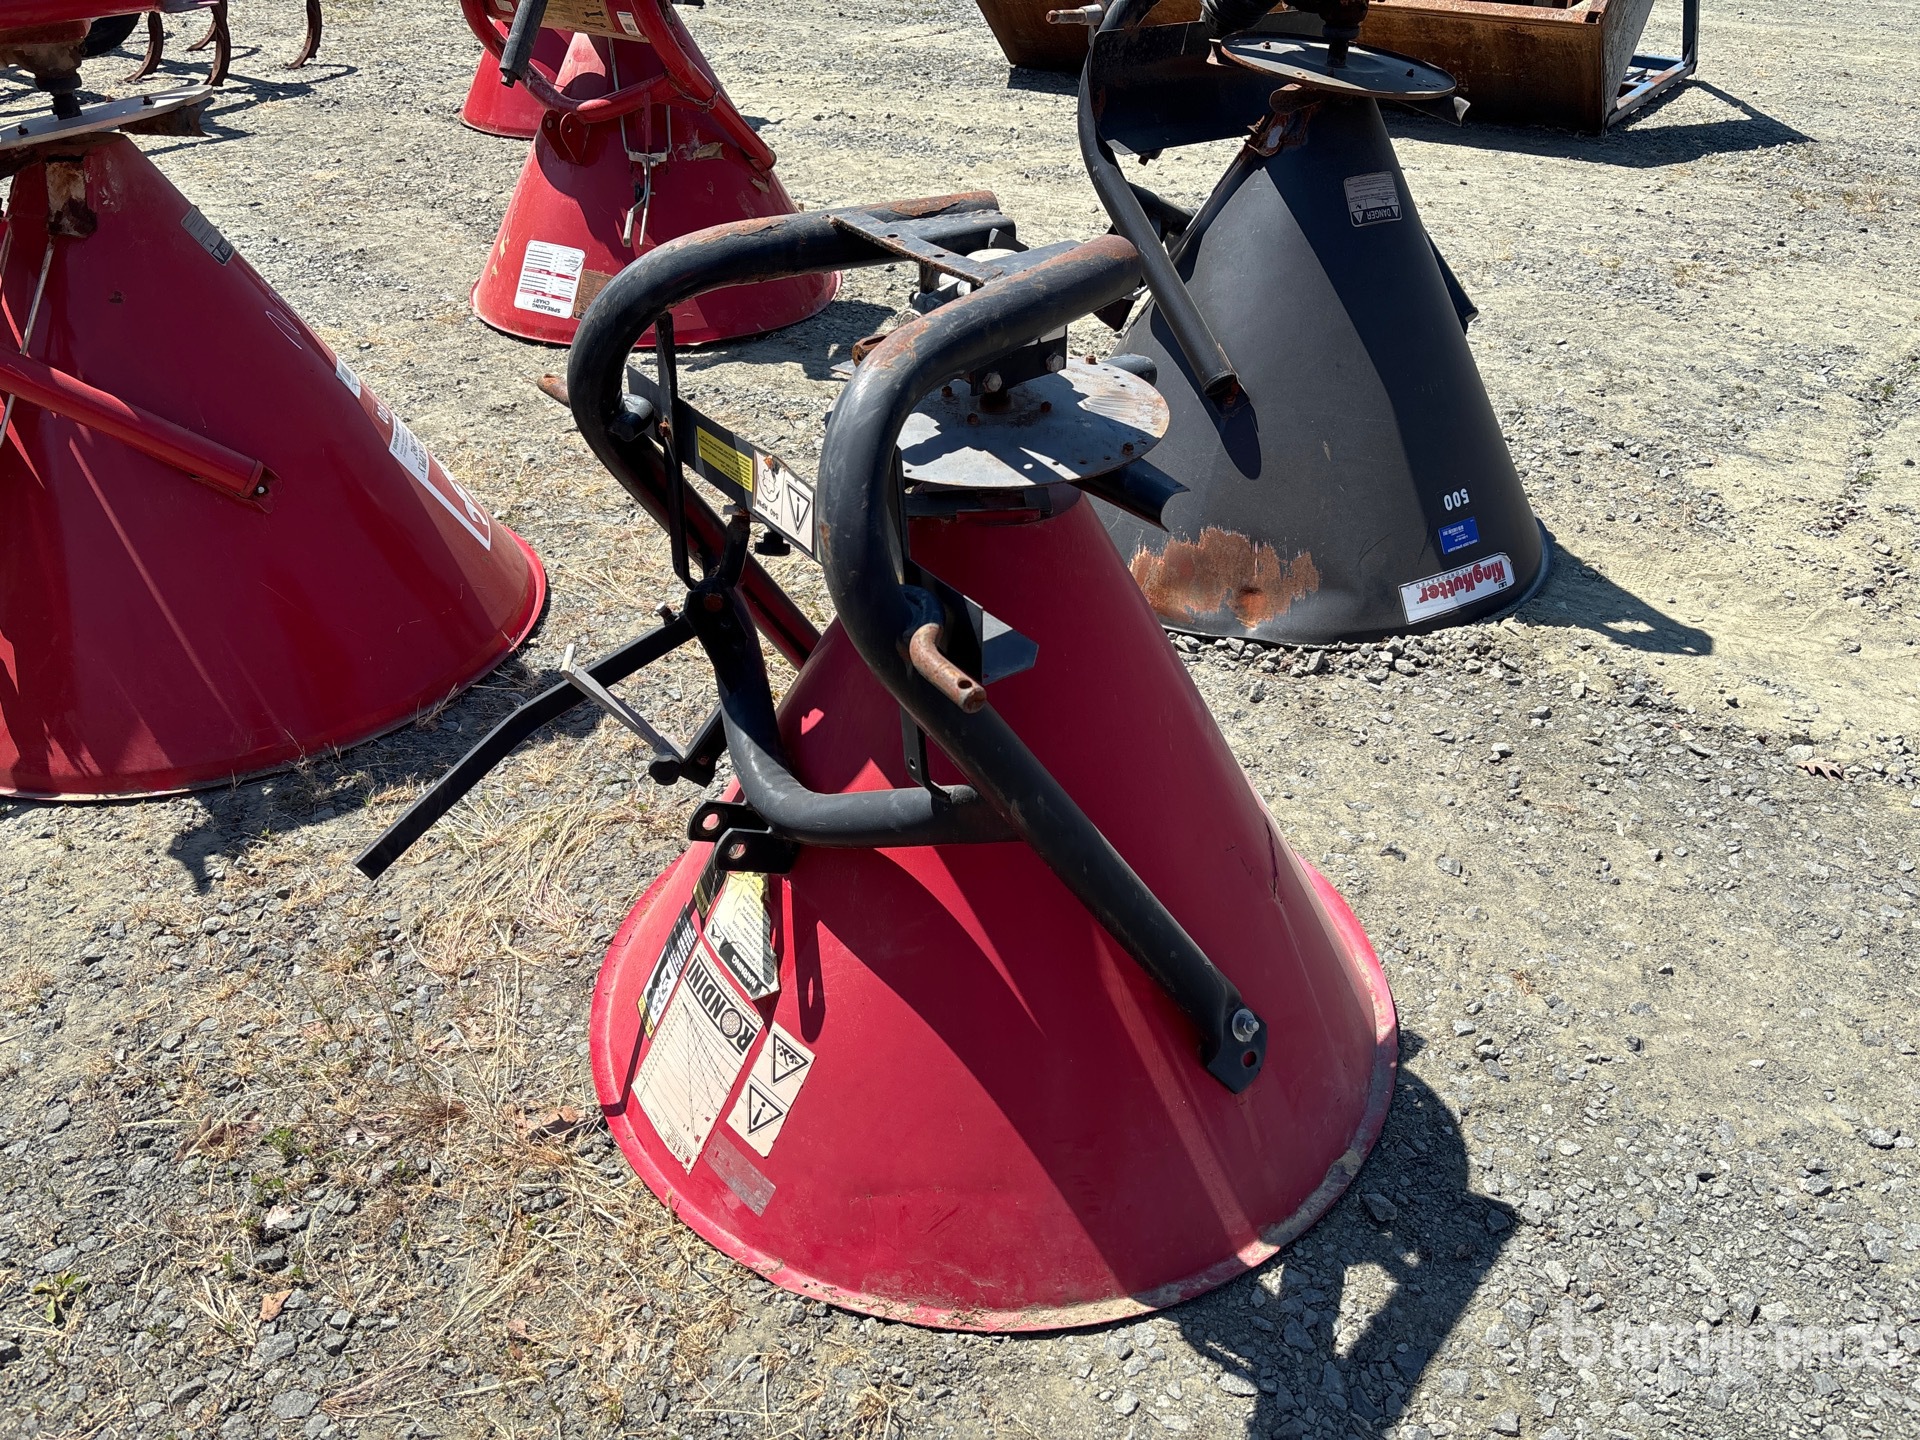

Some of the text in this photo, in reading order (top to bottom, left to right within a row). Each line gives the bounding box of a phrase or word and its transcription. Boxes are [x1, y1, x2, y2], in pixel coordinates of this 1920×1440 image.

[1366, 208, 1391, 220] DANGER
[532, 303, 561, 314] SPREADING
[533, 298, 550, 306] CHART
[1443, 488, 1470, 511] 500
[731, 954, 759, 988] WARNING
[686, 958, 754, 1052] RONDINI
